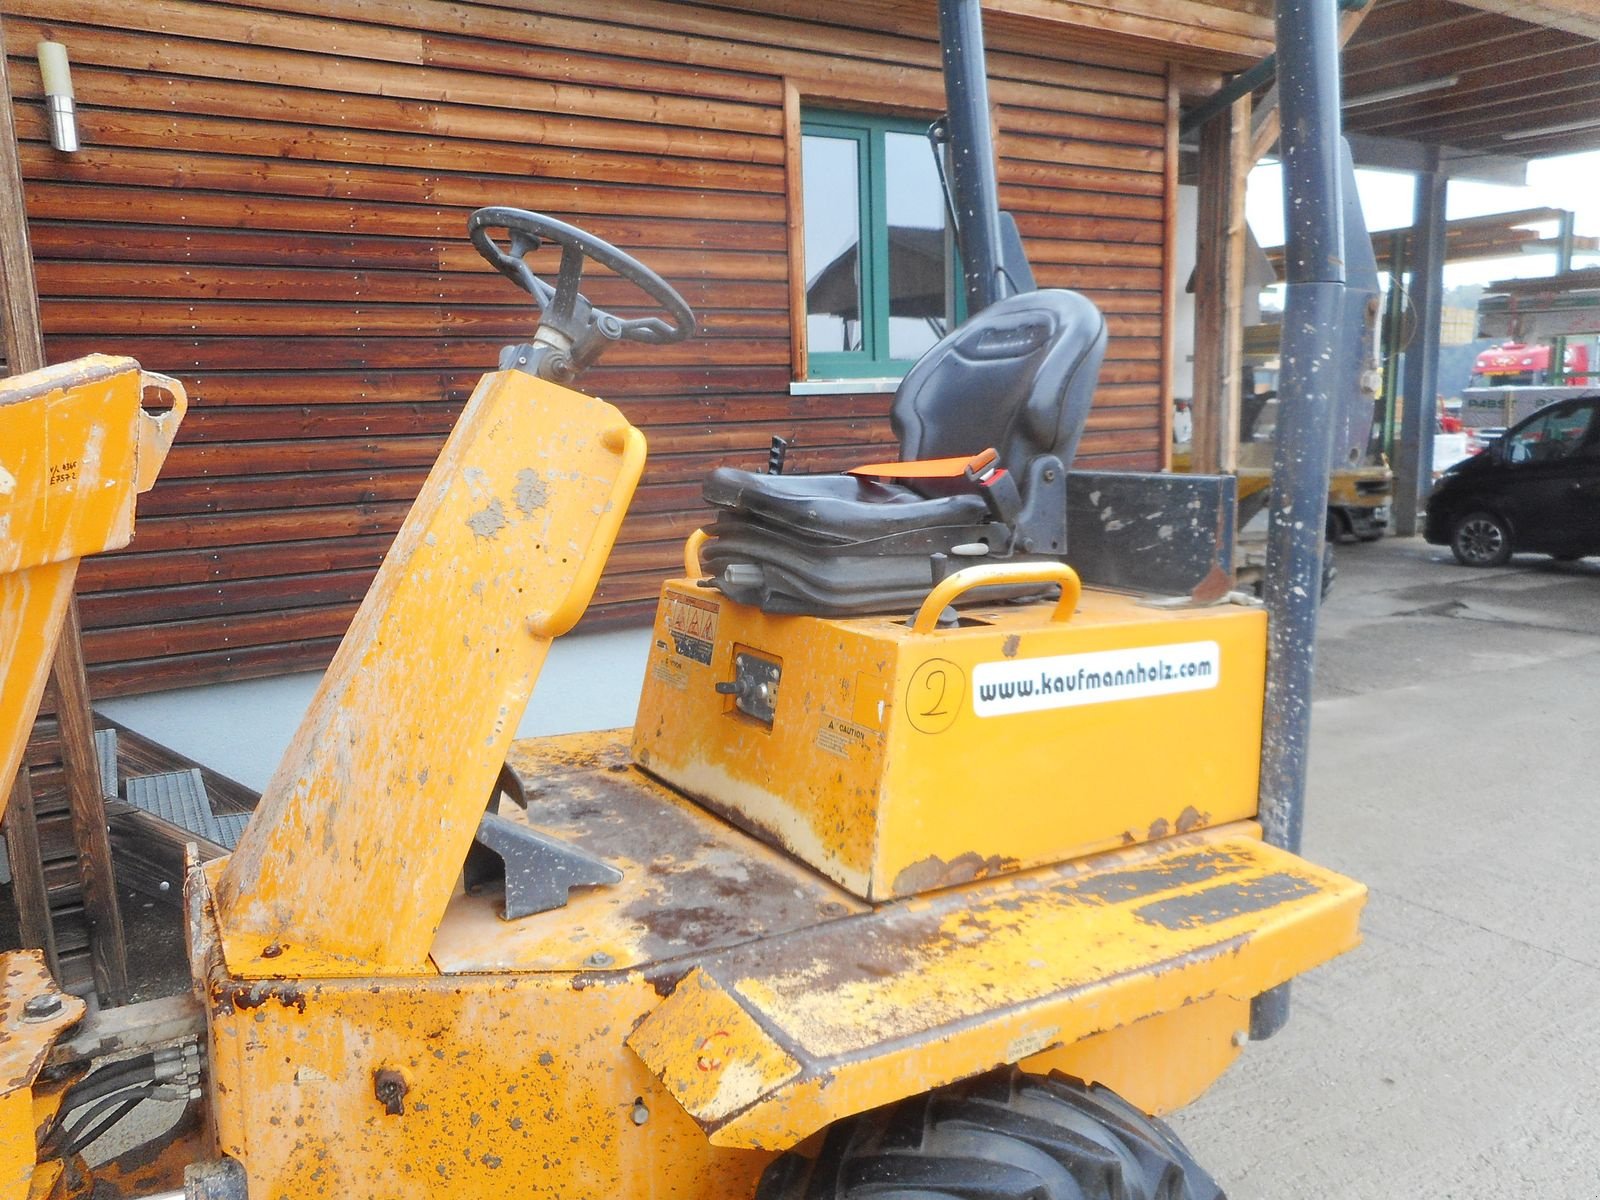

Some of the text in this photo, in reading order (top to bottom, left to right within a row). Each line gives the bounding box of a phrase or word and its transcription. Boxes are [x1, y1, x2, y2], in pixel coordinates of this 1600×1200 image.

[920, 670, 947, 716] 2
[979, 660, 1212, 702] www.kaufmannholz.com
[839, 724, 865, 740] CAUTION
